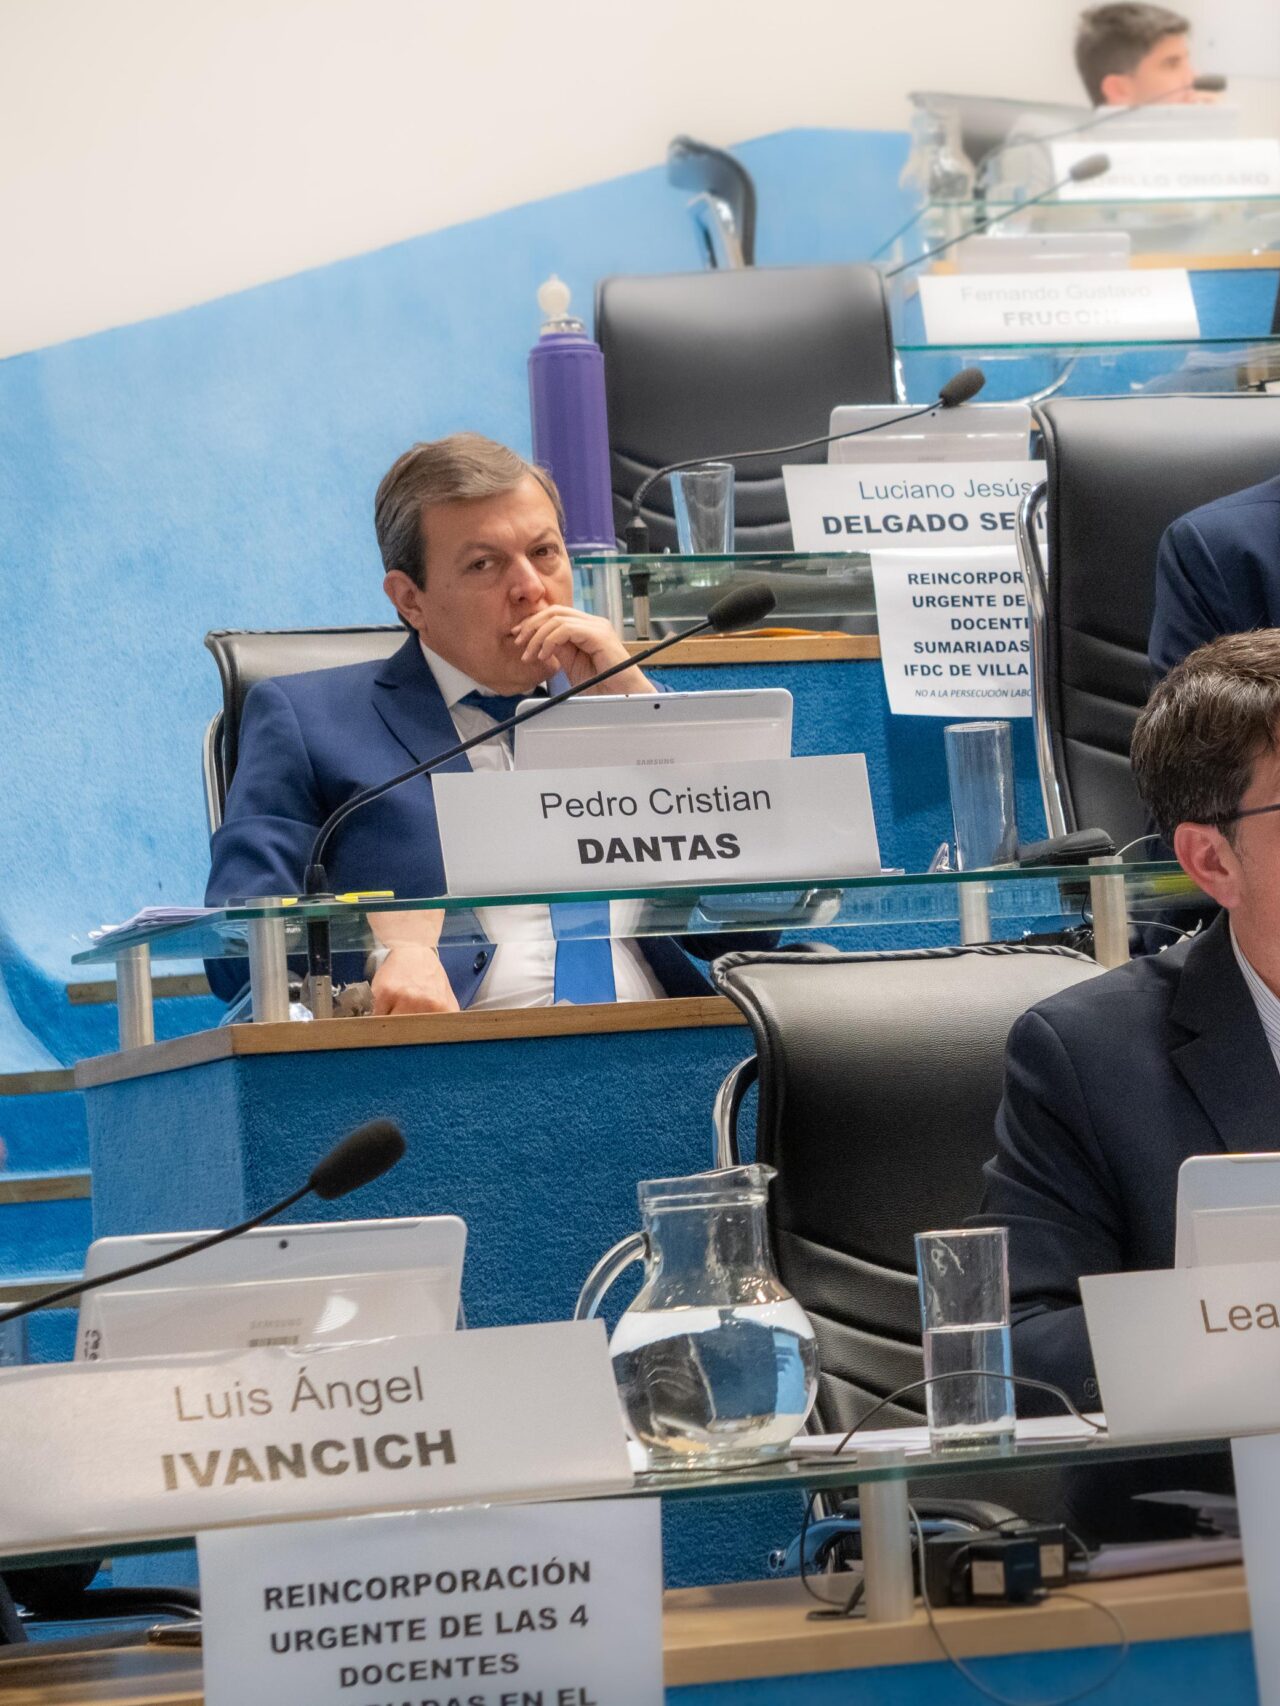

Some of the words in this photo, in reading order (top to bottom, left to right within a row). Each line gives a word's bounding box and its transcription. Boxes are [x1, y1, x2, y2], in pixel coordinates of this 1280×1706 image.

[960, 285, 1060, 303] Fernando
[1065, 282, 1153, 300] Gustavo
[858, 480, 955, 500] Luciano
[963, 478, 1032, 498] Jesús
[822, 513, 969, 535] DELGADO
[907, 572, 1024, 586] REINCORPOR
[912, 595, 997, 608] URGENTE
[1003, 595, 1026, 607] DE
[913, 640, 1031, 654] SUMARIADAS
[904, 664, 944, 677] IFDC
[949, 664, 973, 677] DE
[977, 662, 1029, 676] VILLA
[915, 689, 929, 698] NO
[929, 689, 937, 698] A
[937, 689, 949, 698] LA
[950, 687, 1009, 699] PERSECUCIÓN
[540, 791, 638, 820] Pedro
[649, 785, 772, 815] Cristian
[577, 833, 741, 865] DANTAS
[174, 1383, 273, 1423] Luis
[290, 1366, 426, 1417] Ángel
[161, 1429, 457, 1492] IVANCICH
[263, 1557, 592, 1611] REINCORPORACIÓN
[270, 1618, 427, 1655] URGENTE
[440, 1613, 483, 1639] DE
[496, 1608, 559, 1635] LAS
[569, 1604, 589, 1628] 4
[339, 1652, 520, 1689] DOCENTES
